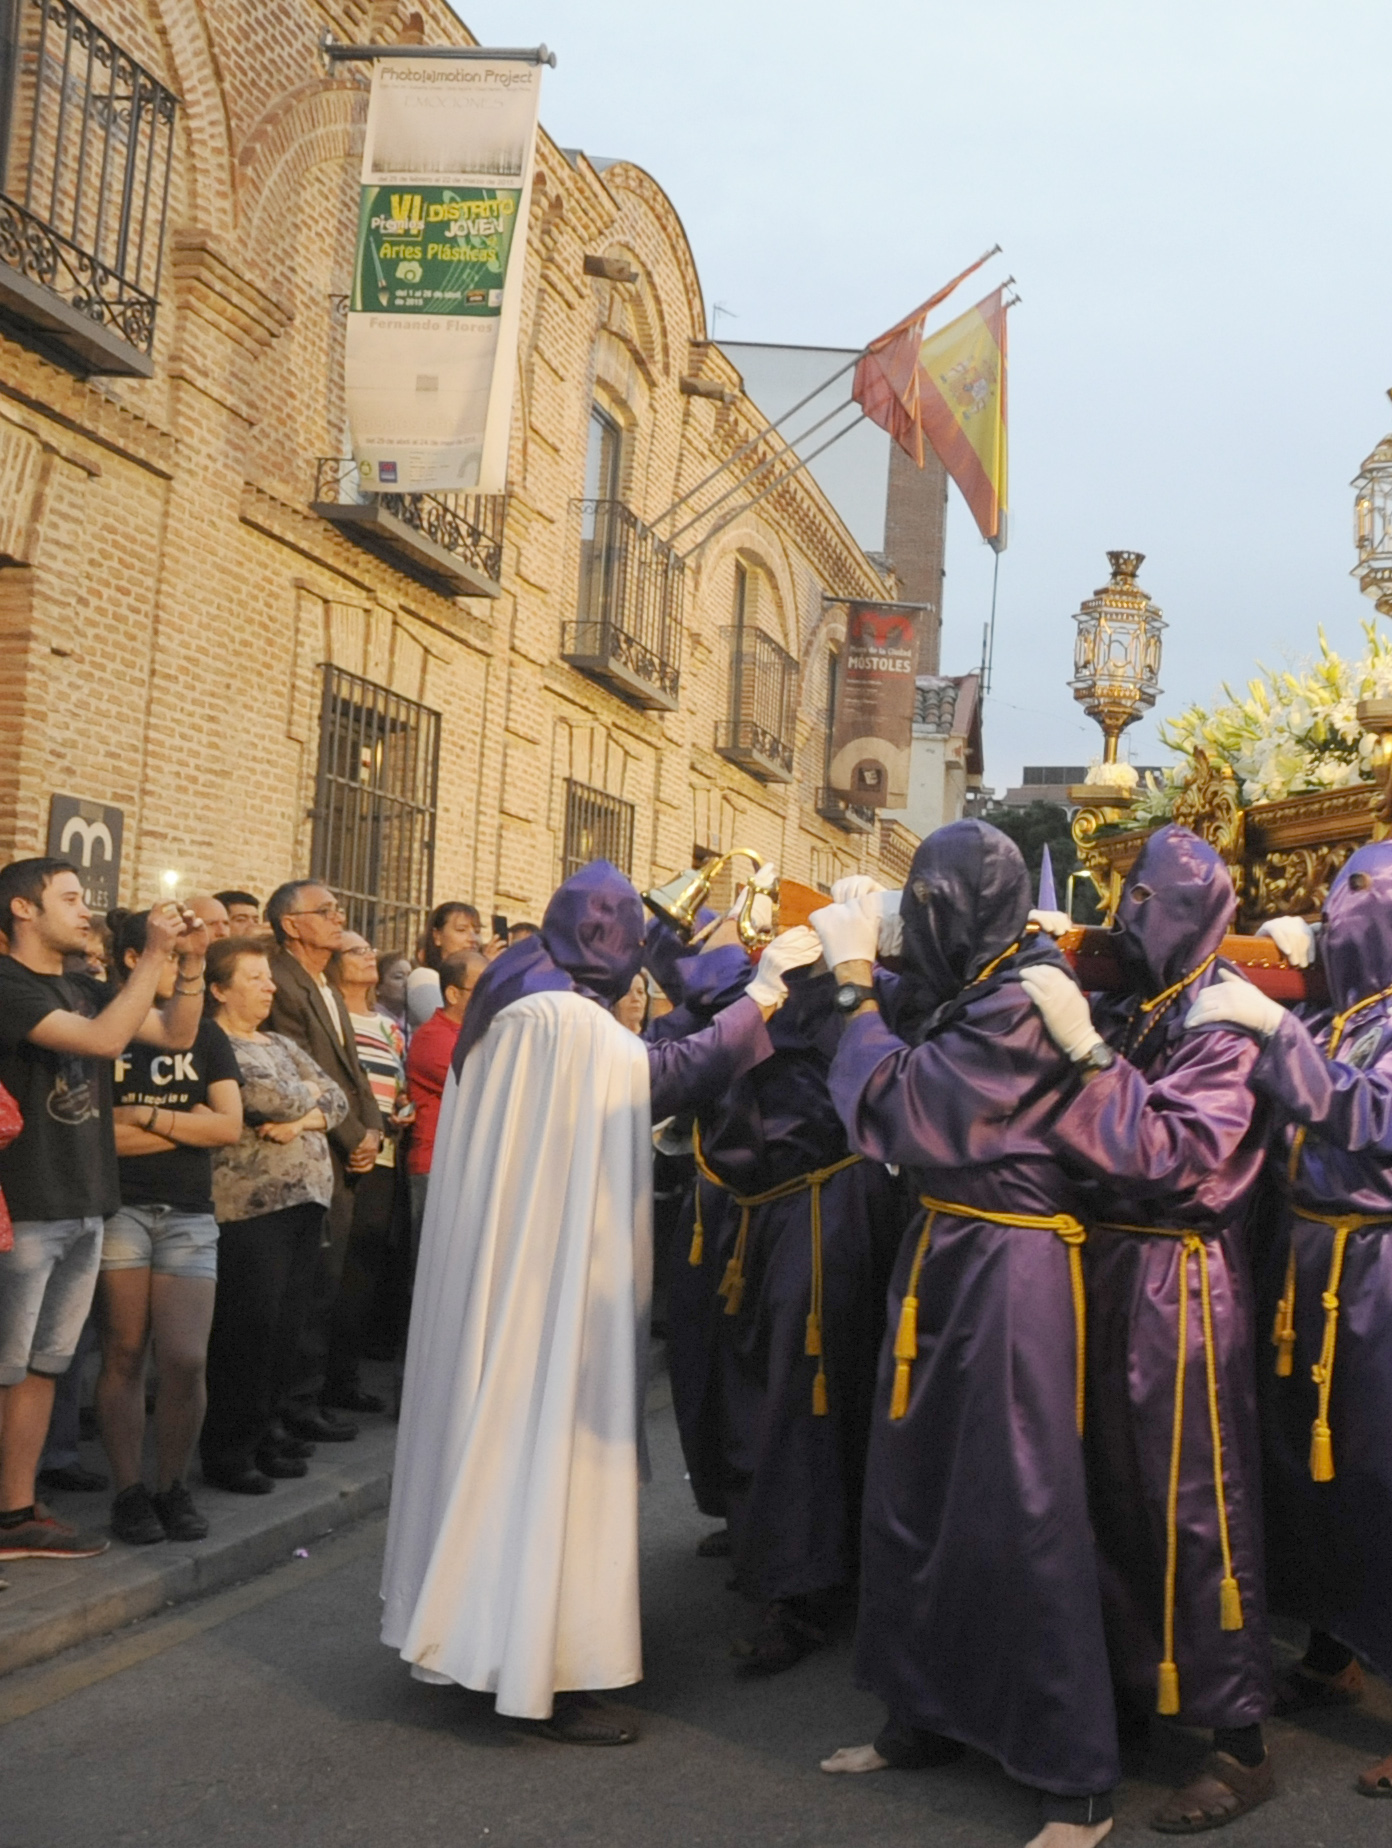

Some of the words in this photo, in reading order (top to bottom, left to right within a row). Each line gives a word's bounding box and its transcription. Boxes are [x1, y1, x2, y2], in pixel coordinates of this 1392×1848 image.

[484, 69, 533, 87] Project
[429, 198, 515, 222] DISTRITO
[371, 216, 425, 231] Premios
[444, 217, 504, 238] JOVEN
[380, 242, 422, 259] Artes
[427, 242, 497, 261] Plásticas
[369, 317, 440, 331] Fernando
[446, 319, 493, 333] Flores
[848, 654, 911, 673] MÓSTOLES
